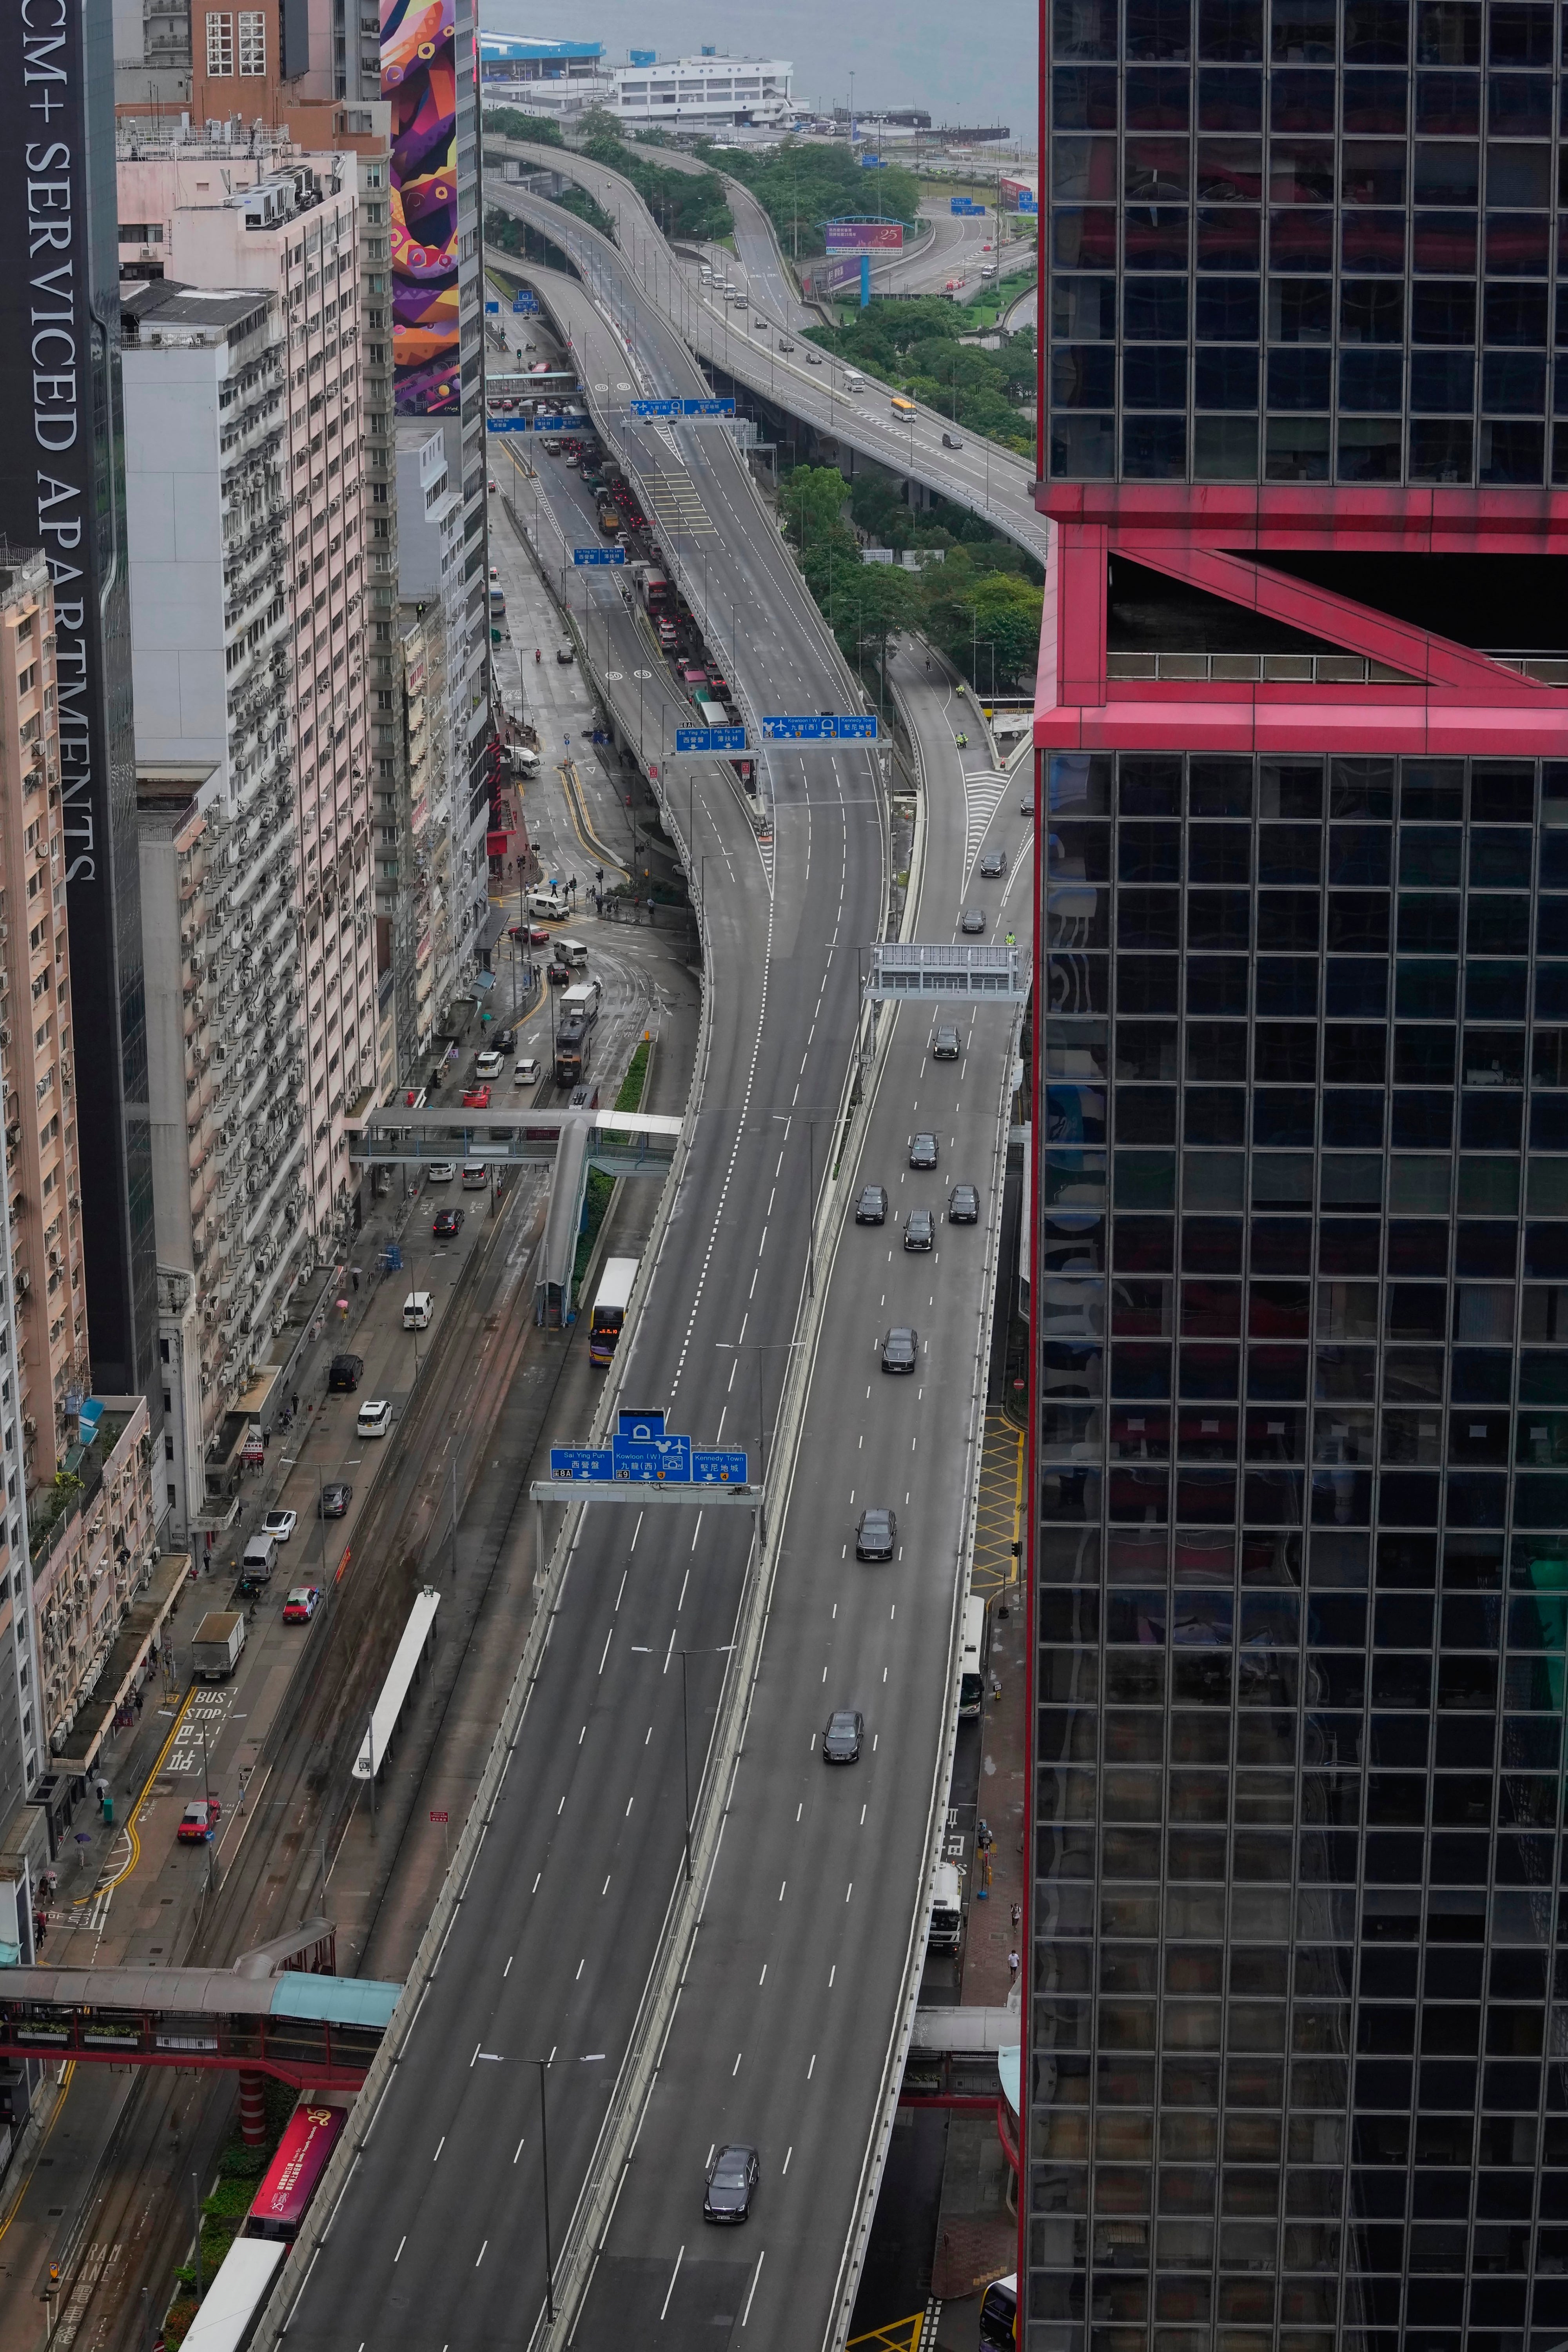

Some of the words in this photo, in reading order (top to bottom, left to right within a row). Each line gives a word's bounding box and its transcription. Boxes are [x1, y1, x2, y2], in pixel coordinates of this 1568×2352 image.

[879, 228, 900, 240] 25
[25, 142, 78, 451] SERVICED
[37, 470, 96, 883] APARTMENTS
[572, 1461, 599, 1469] 西營盤
[194, 1692, 227, 1703] BUS
[183, 1708, 222, 1720] STOP
[174, 1726, 210, 1744] 巴士
[166, 1750, 196, 1770] 站
[272, 2202, 284, 2212] 25
[77, 2243, 122, 2262] TRAM
[65, 2263, 115, 2281] LANE
[71, 2285, 94, 2303] 電
[61, 2305, 84, 2323] 車
